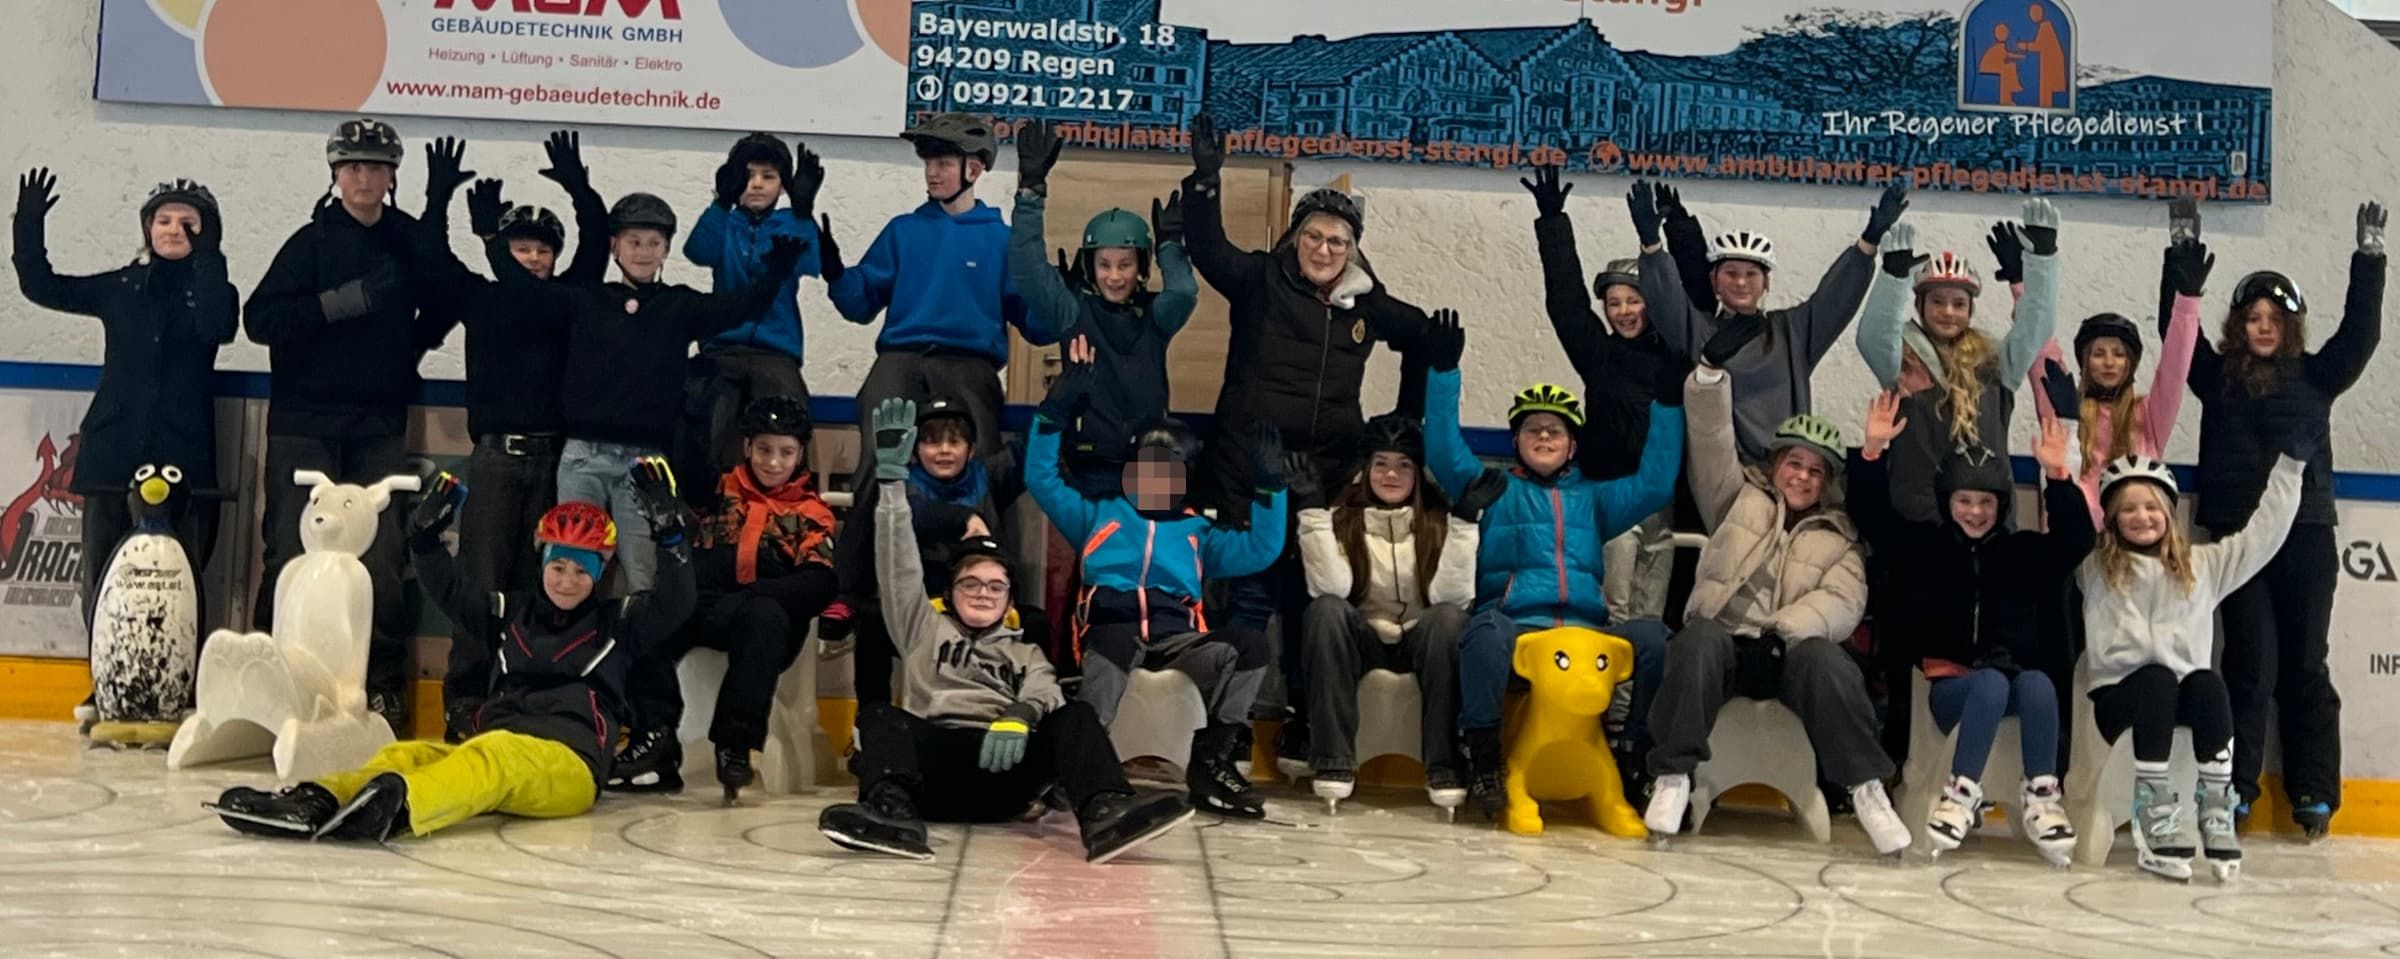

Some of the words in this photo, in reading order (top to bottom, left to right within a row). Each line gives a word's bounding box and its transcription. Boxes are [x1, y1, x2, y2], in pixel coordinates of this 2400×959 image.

[431, 17, 614, 40] GEBÄUDETECHNIK
[622, 26, 684, 43] GMBH
[918, 12, 1127, 44] Bayerwaldstr.
[1139, 24, 1176, 46] 18
[428, 47, 486, 65] Heizung
[501, 51, 553, 68] Lüftung
[569, 54, 619, 69] Sanitär
[635, 57, 683, 71] Elektro
[916, 45, 1011, 70] 94209
[1022, 50, 1116, 80] Regen
[386, 80, 721, 110] www.mam-gebaeudetechnik.de
[953, 81, 1046, 107] 09921
[1058, 88, 1135, 111] 2217
[1822, 110, 1877, 136] Ihr
[1887, 110, 2001, 144] Regener
[2009, 108, 2188, 144] Pflegedienst
[1627, 151, 2268, 200] www.ambulanter-pflegedienst-stangl.de
